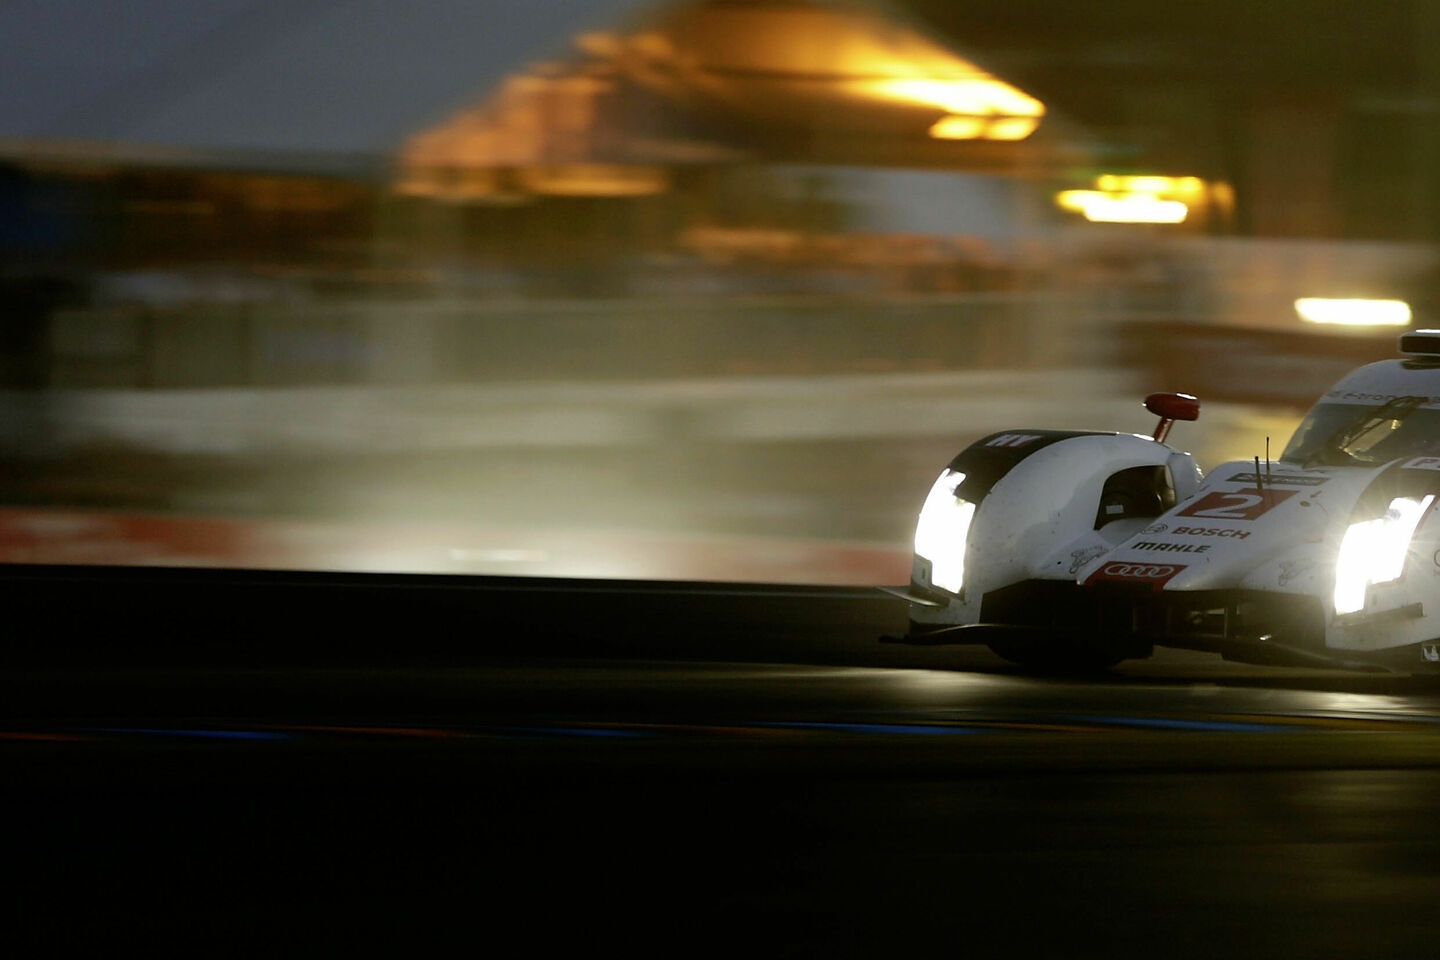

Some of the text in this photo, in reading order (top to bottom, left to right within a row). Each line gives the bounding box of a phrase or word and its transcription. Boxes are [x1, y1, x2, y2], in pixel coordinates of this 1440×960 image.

[1192, 494, 1264, 517] 2
[1171, 526, 1253, 540] BOSCH
[1131, 542, 1211, 554] MAHLE
